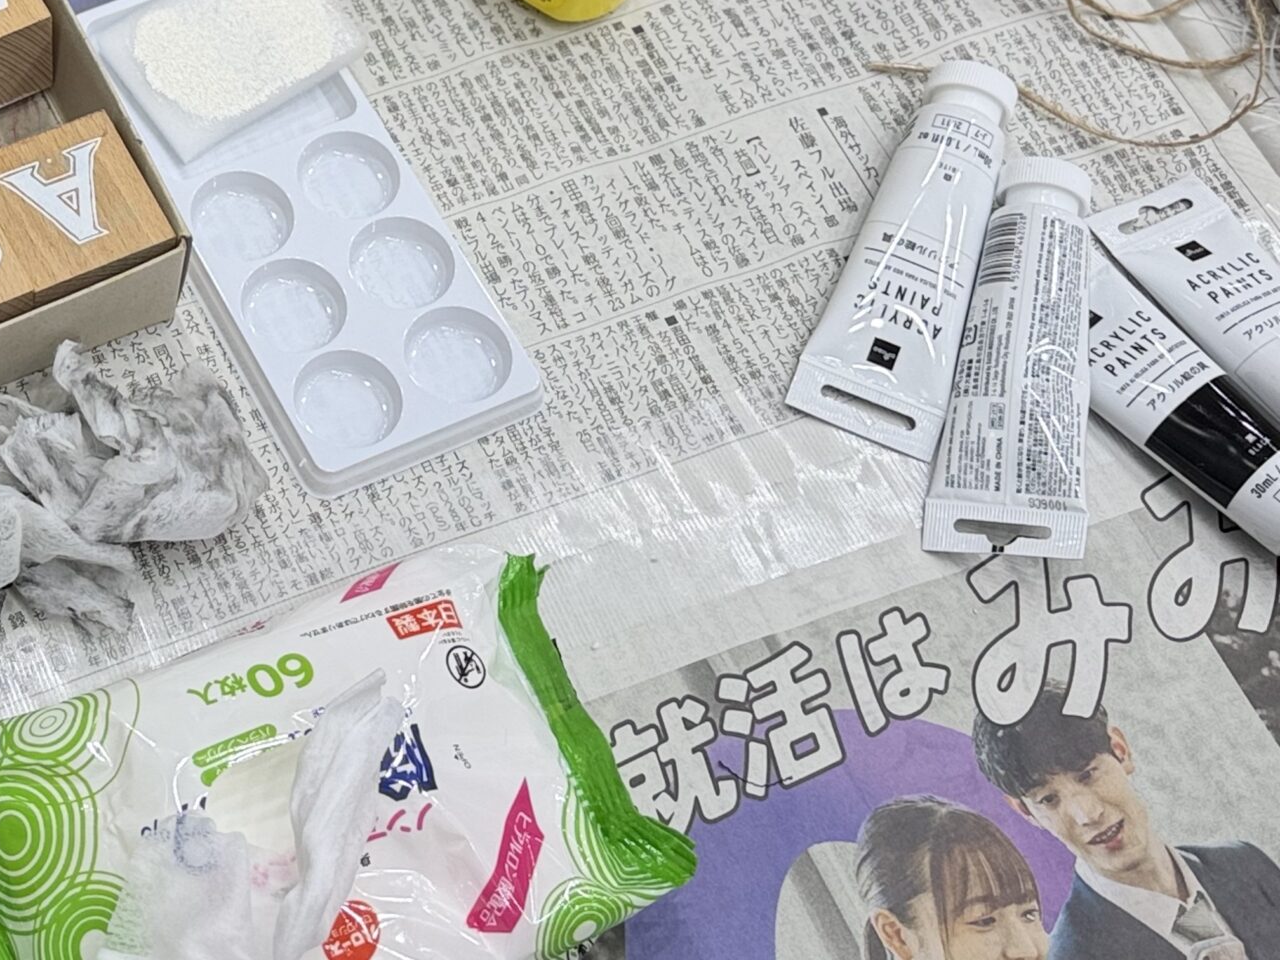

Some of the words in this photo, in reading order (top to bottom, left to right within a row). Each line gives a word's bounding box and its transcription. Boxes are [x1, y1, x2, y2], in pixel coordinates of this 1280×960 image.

[785, 113, 859, 217] 佐藤フル出場
[830, 113, 882, 186] 海外サッカ
[867, 275, 942, 315] PAINTS
[1184, 251, 1263, 293] ACRYLIC
[1206, 268, 1275, 304] PAINTS
[1103, 325, 1168, 379] PAINTS
[1248, 469, 1278, 501] 30mL
[184, 652, 316, 715] 60枚入
